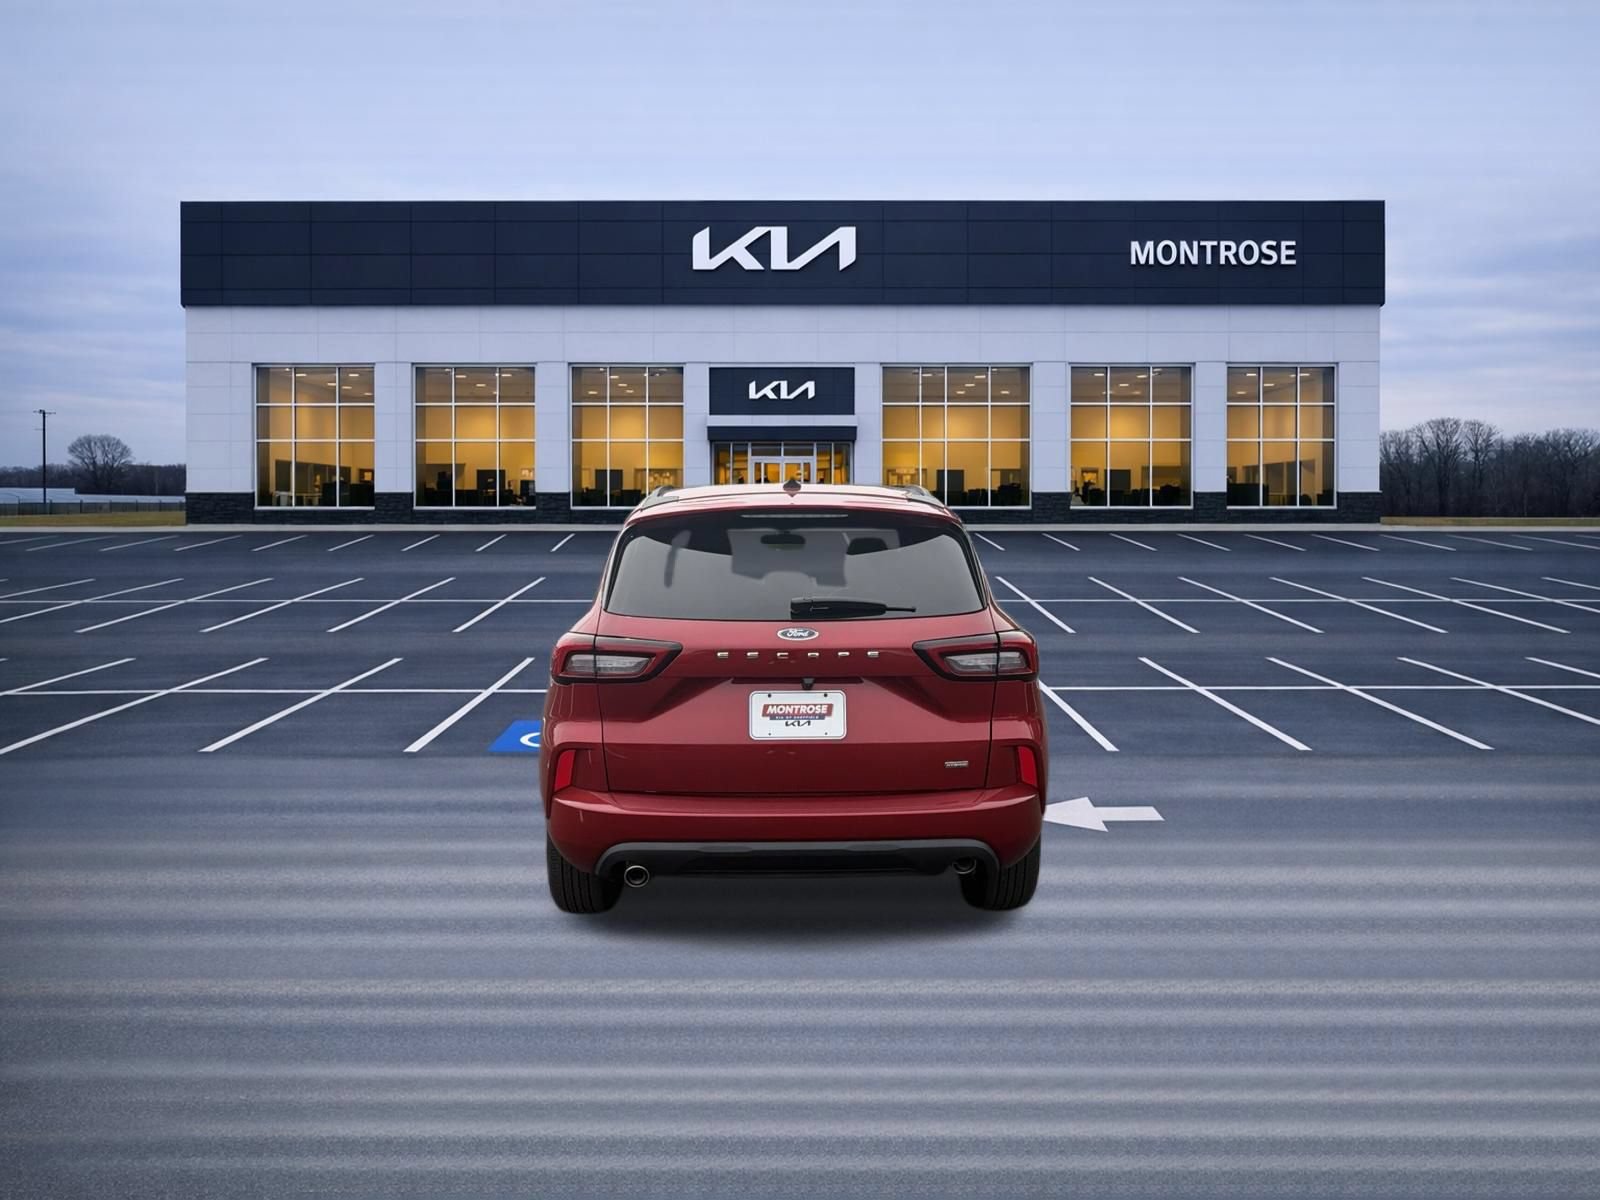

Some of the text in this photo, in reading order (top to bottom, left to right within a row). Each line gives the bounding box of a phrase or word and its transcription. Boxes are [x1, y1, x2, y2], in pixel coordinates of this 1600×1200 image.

[692, 226, 856, 271] KIA
[1130, 240, 1297, 265] MONTROSE
[748, 380, 816, 400] KIA
[766, 704, 829, 714] MONTROSE
